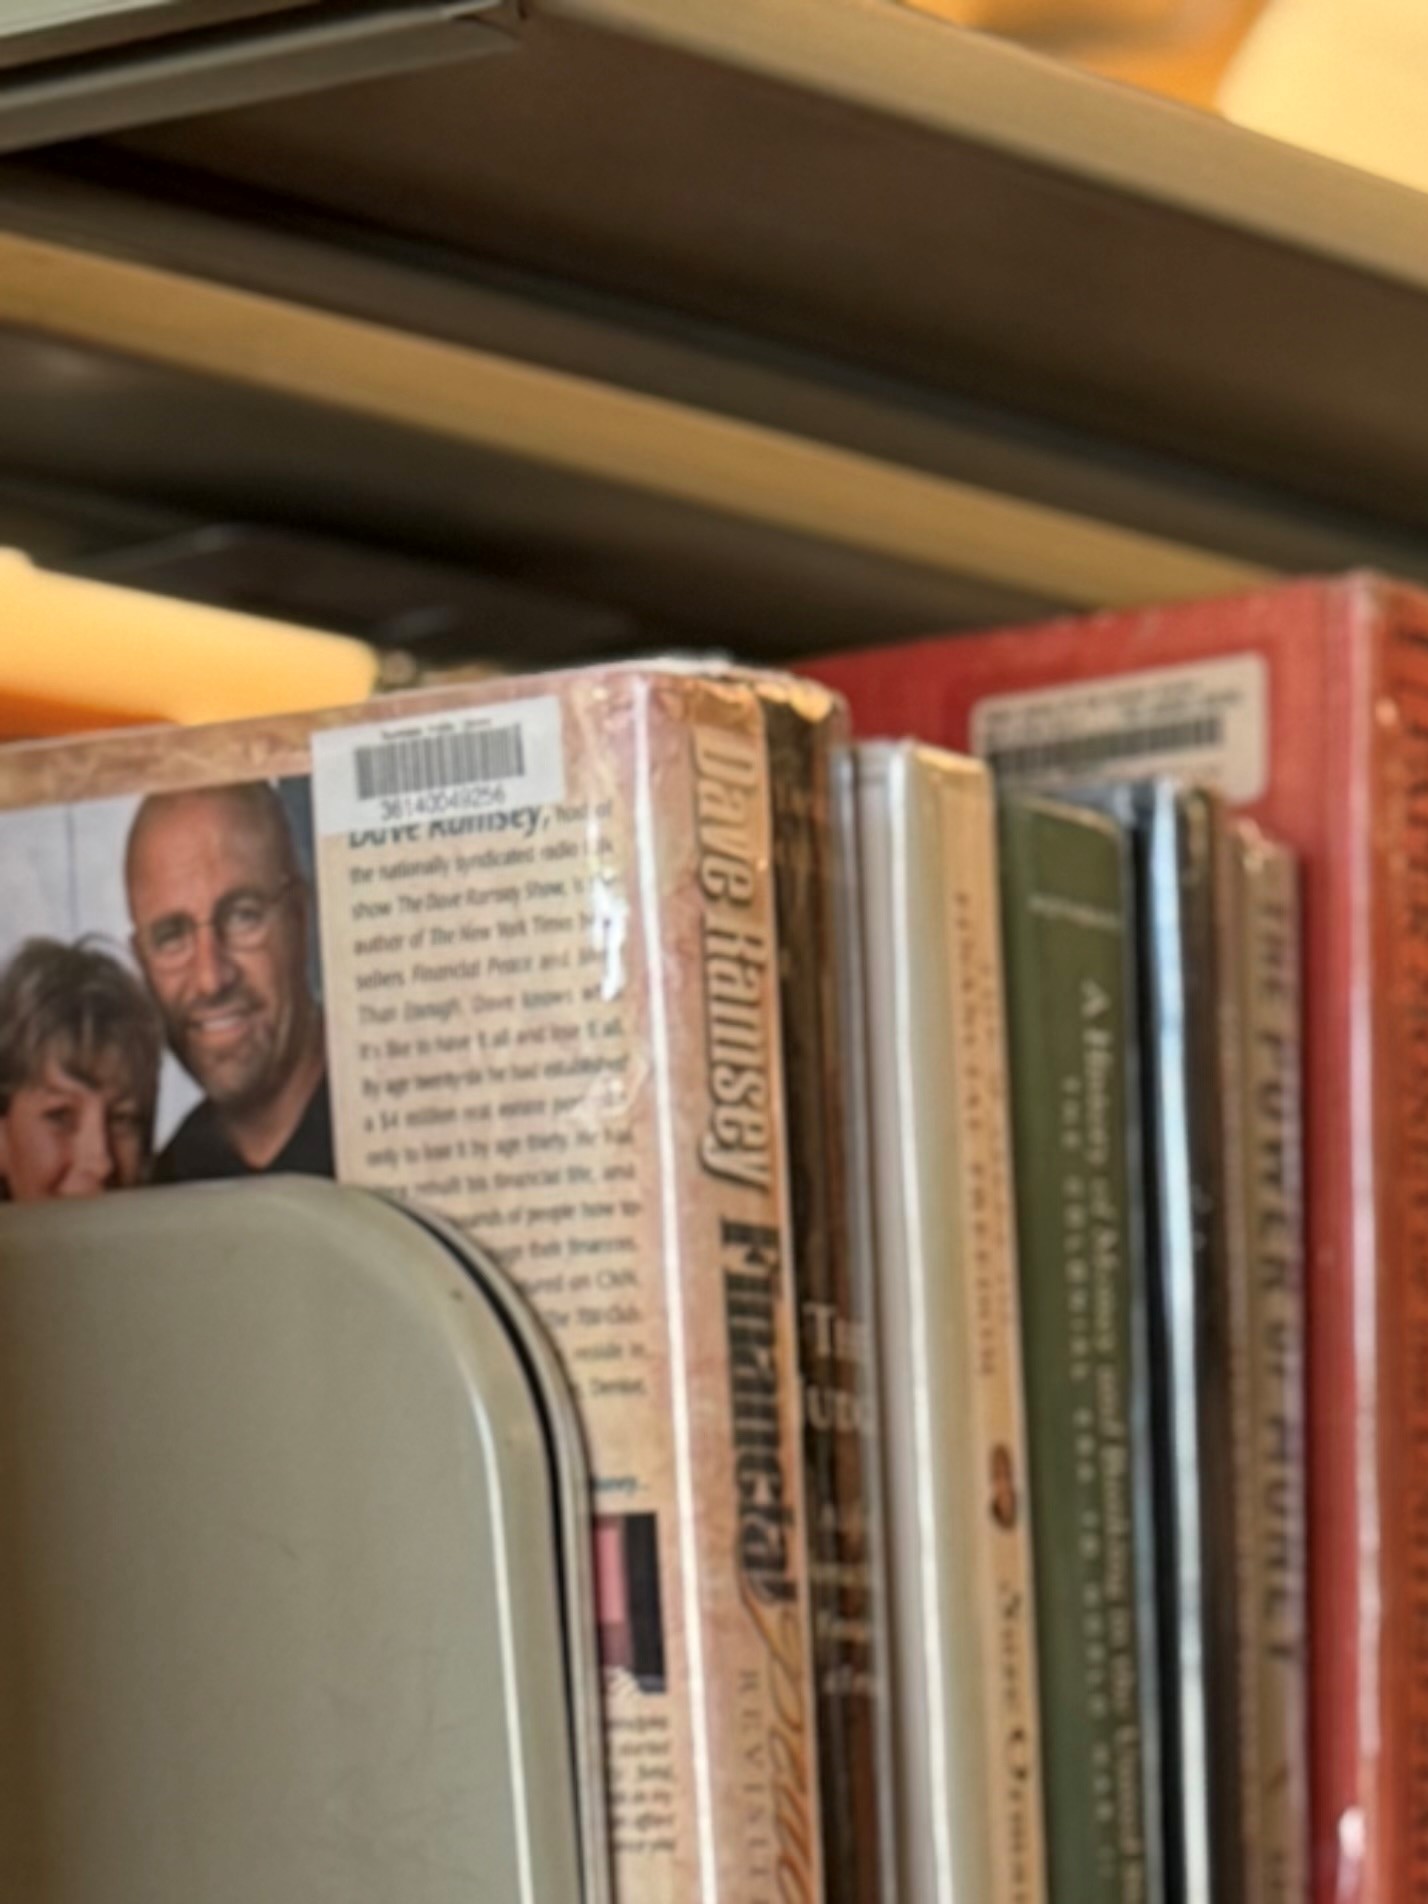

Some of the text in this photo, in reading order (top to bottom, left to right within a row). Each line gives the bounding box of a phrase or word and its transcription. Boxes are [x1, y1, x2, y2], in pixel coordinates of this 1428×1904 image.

[692, 725, 775, 1198] Dave Ramsey
[1082, 1028, 1116, 1166] History
[1089, 1226, 1123, 1358] Money
[724, 1221, 798, 1605] Financial
[1095, 1366, 1128, 1439] and
[1097, 1445, 1134, 1602] Banking
